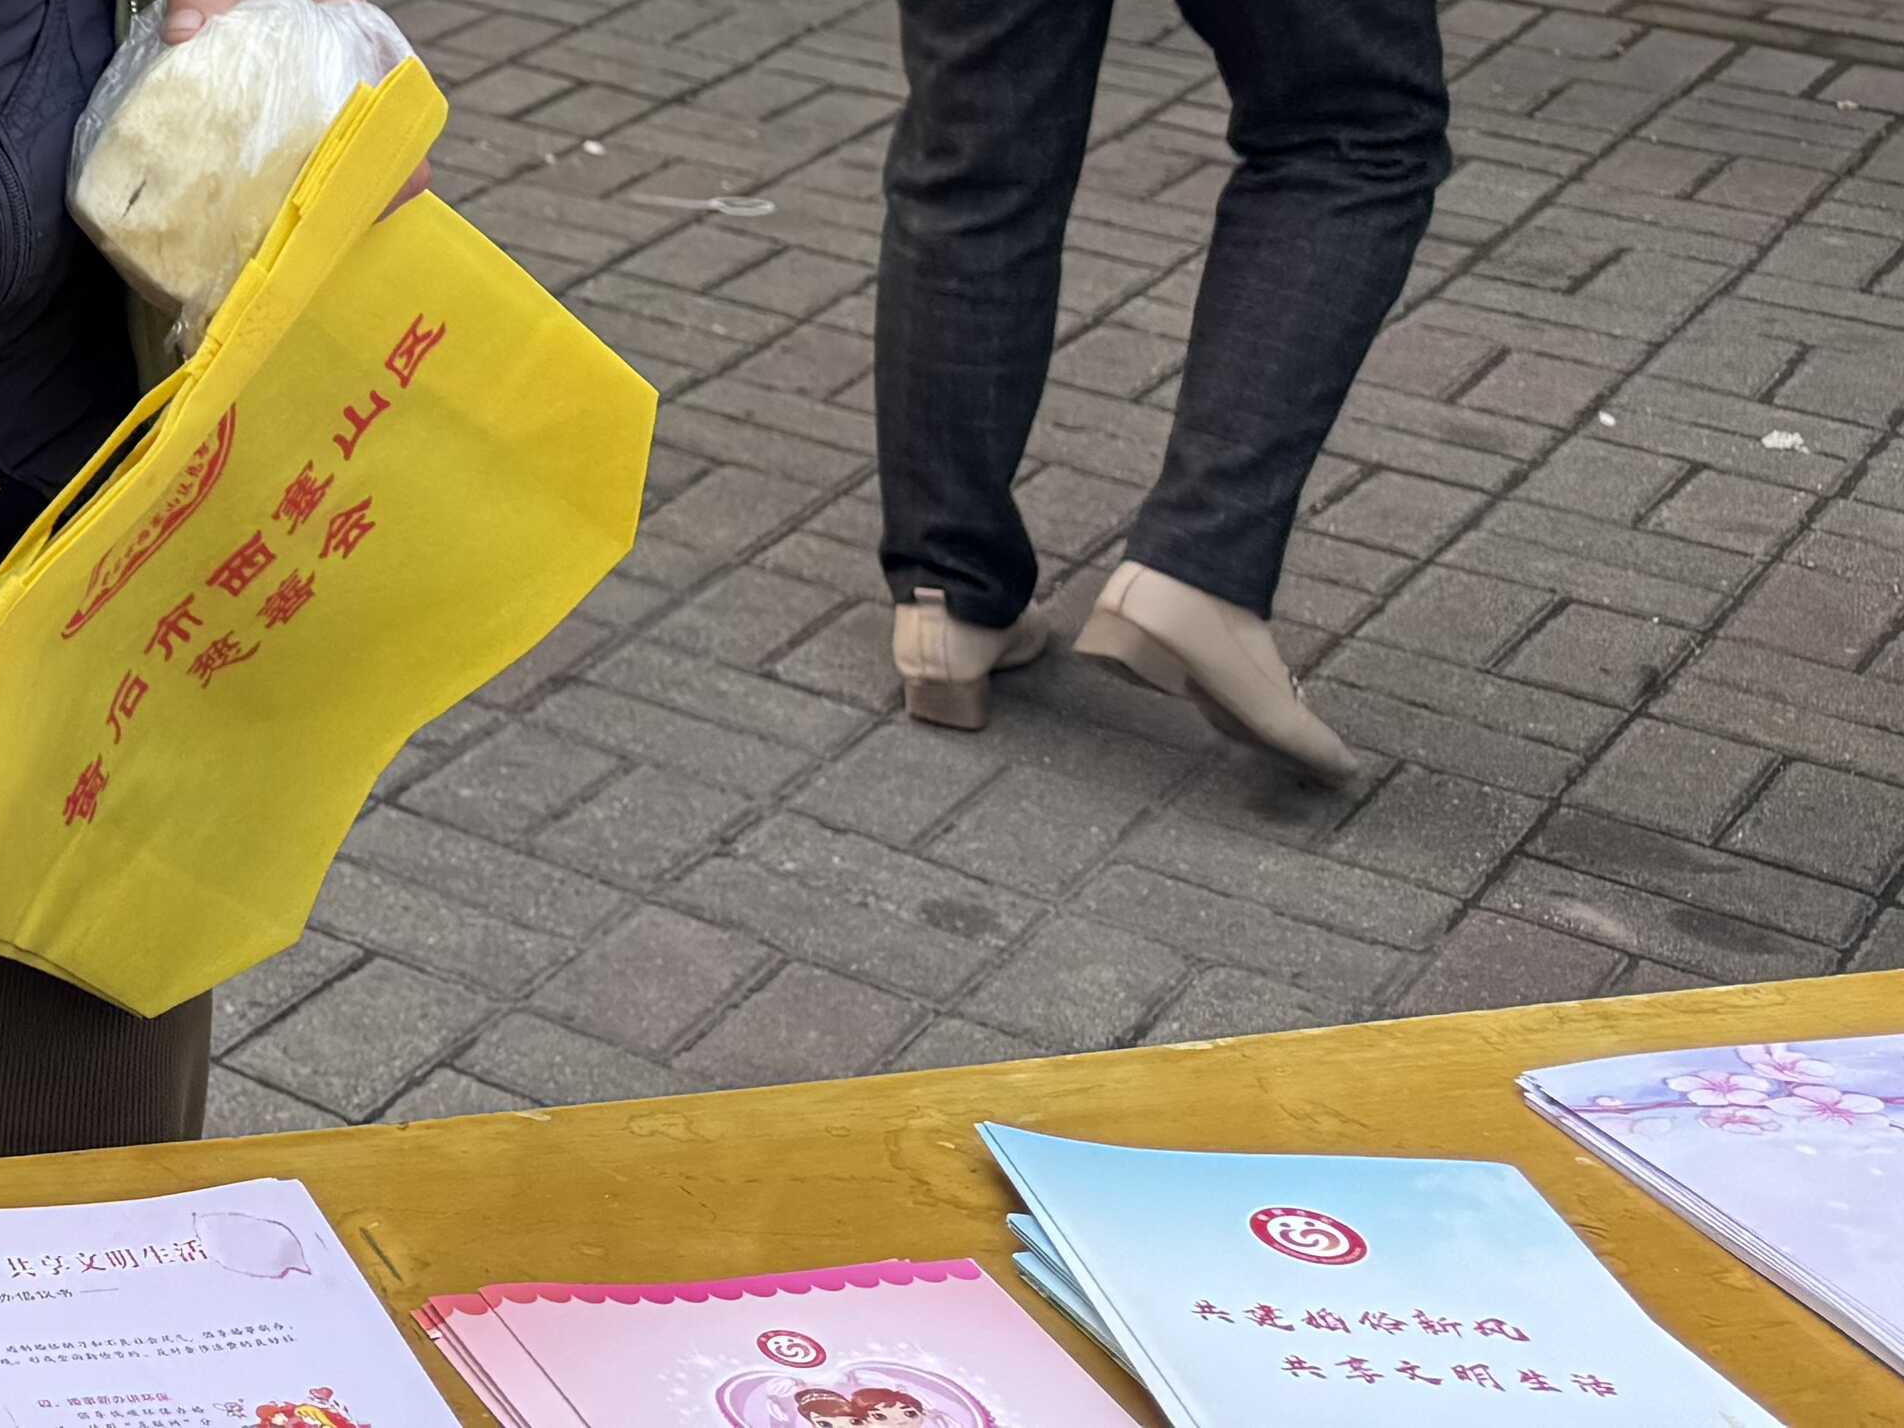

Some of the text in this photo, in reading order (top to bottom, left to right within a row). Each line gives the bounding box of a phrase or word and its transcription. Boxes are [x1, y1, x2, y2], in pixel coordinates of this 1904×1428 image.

[61, 313, 446, 826] 黄石市西塞山区
[187, 495, 376, 689] 慈善会
[7, 1239, 209, 1278] 共享文明生活
[1192, 1298, 1530, 1343] 共建婚俗新风
[1281, 1353, 1618, 1398] 共享文明生活
